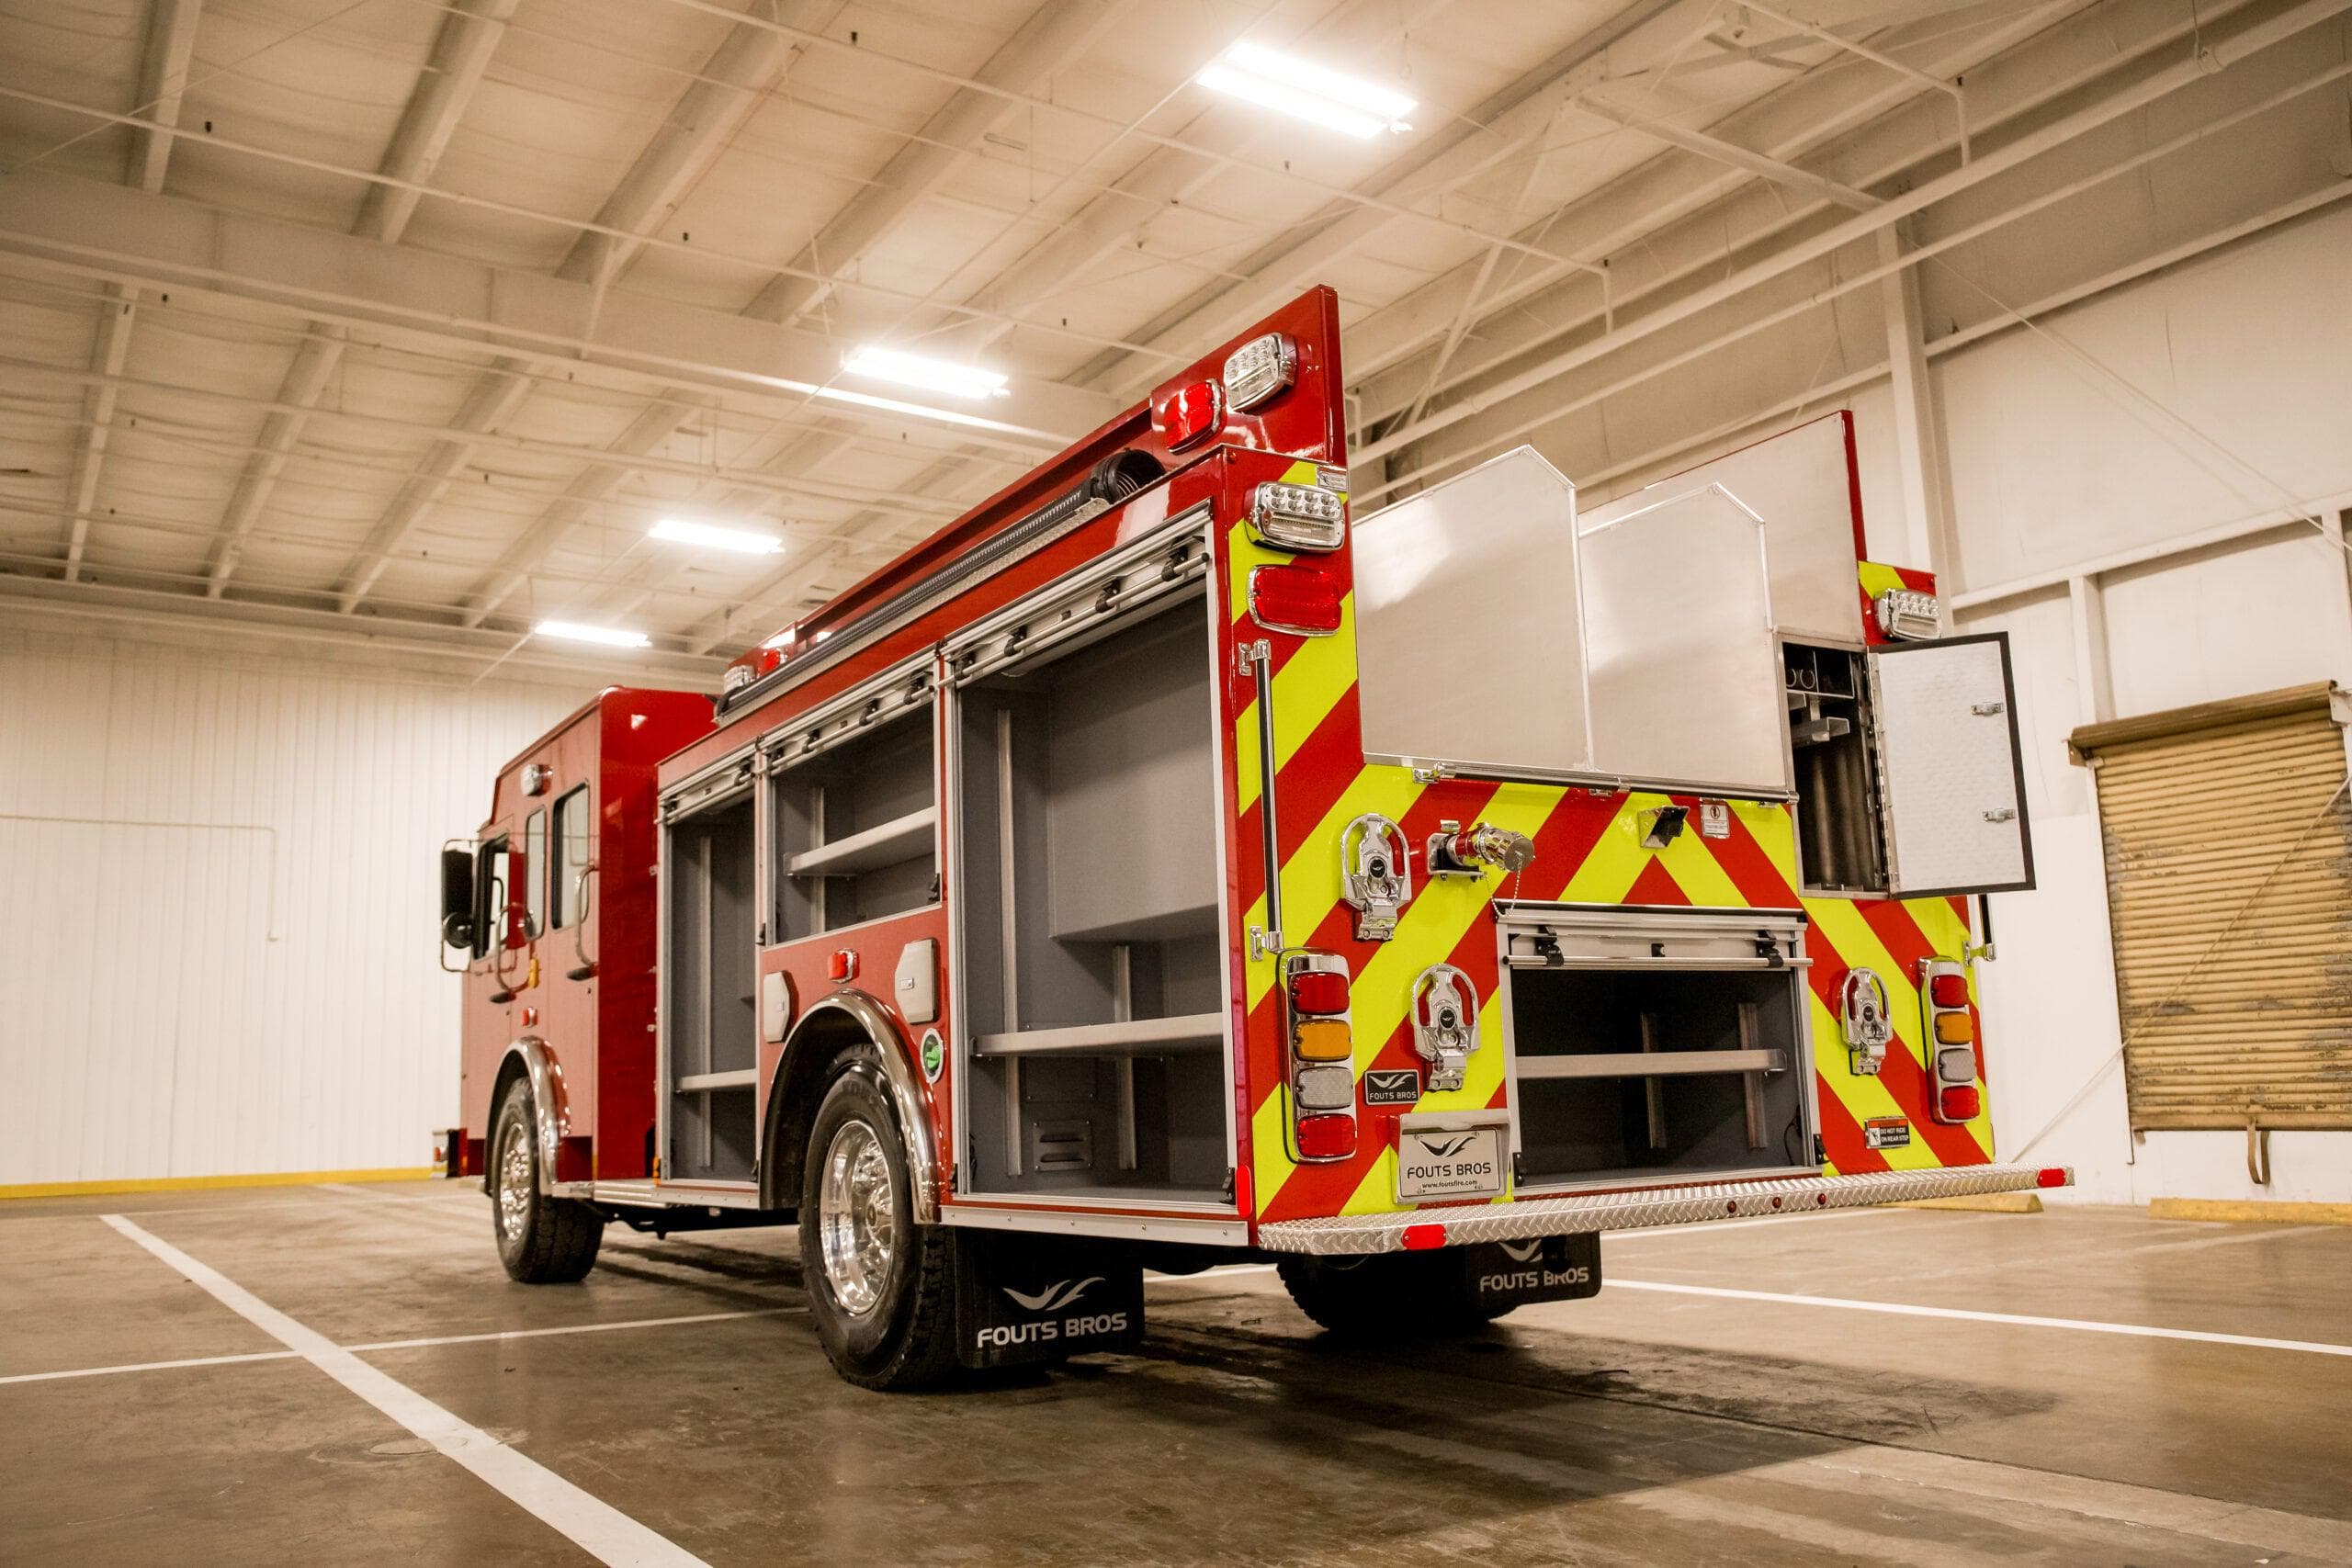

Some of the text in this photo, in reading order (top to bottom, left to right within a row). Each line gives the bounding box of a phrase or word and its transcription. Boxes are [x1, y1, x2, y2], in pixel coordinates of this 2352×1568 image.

[1369, 1091, 1417, 1100] FOUTS BROS
[1407, 1162, 1491, 1179] FOUTS BROS
[1422, 1179, 1478, 1189] www.foutsfire.com
[1479, 1271, 1539, 1292] FOUTS
[977, 1312, 1127, 1348] FOUTS BROS
